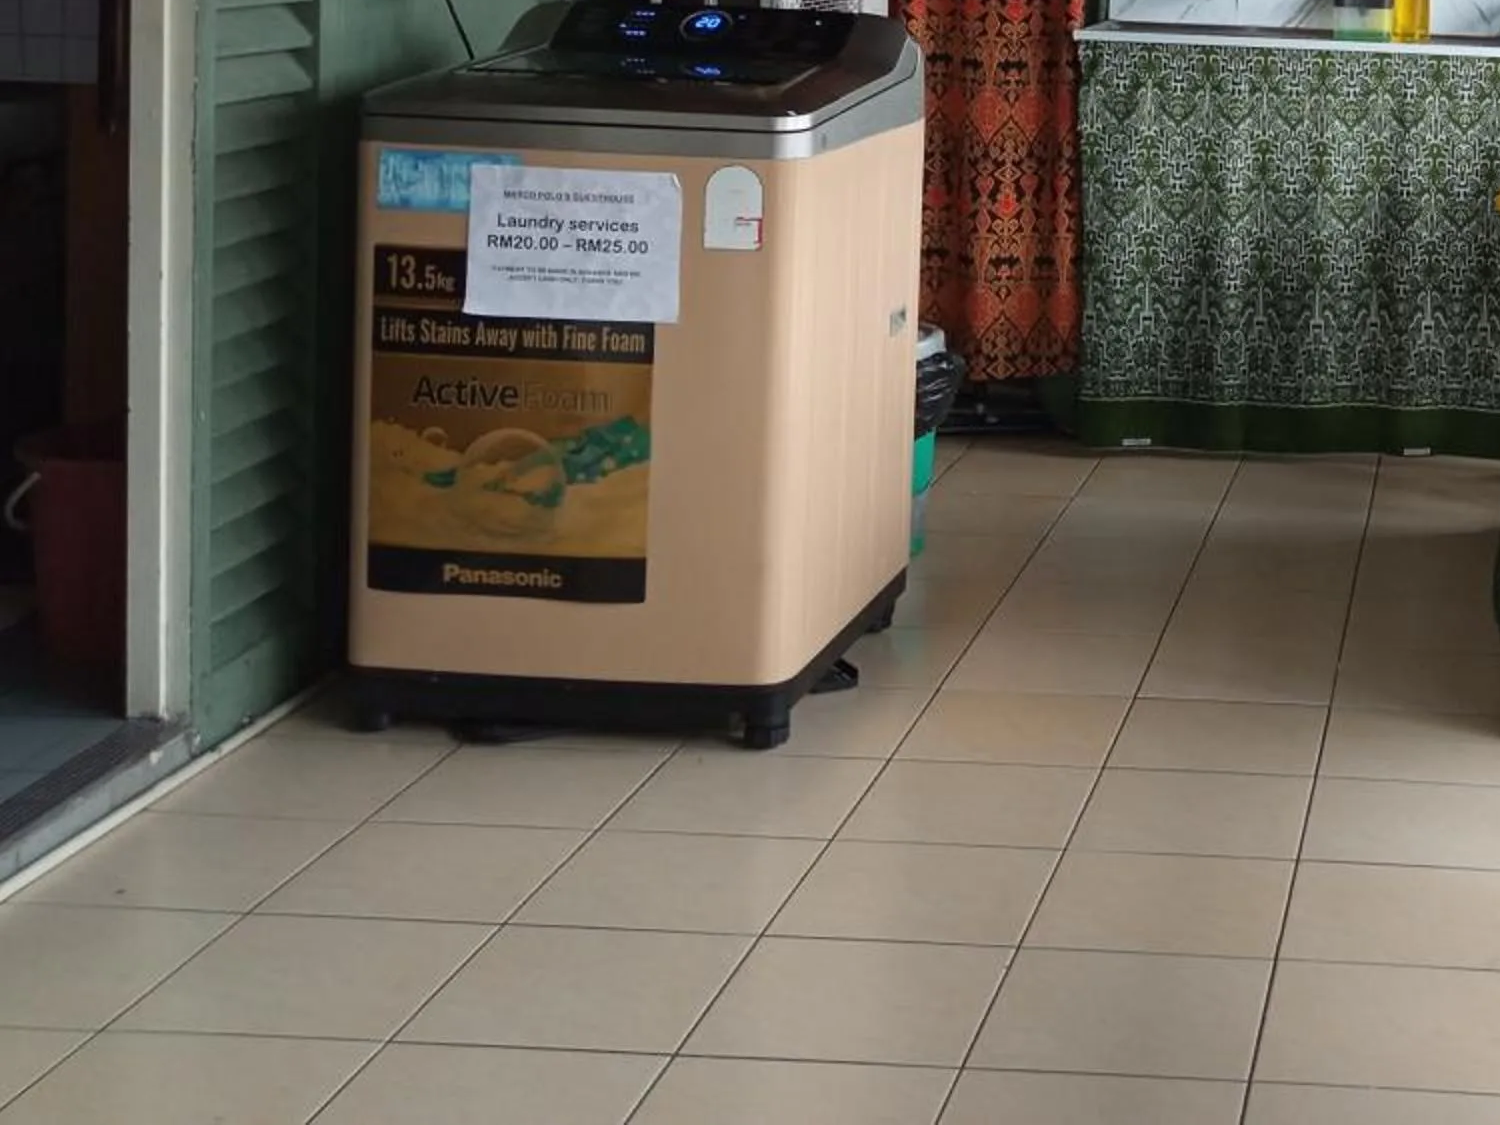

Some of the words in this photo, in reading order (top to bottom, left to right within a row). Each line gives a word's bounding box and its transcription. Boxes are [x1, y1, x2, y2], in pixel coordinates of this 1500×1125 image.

[695, 16, 721, 28] 20
[496, 213, 565, 234] Laundry
[568, 218, 640, 234] services
[487, 234, 559, 252] RM20.00
[575, 238, 649, 255] RM25.00
[386, 252, 456, 292] 13.5kg
[381, 316, 415, 343] Lifts
[420, 318, 471, 346] Stains
[474, 321, 518, 352] Away
[522, 324, 558, 350] with
[562, 323, 598, 352] Fine
[602, 326, 646, 354] Foam
[443, 563, 563, 588] Panasonic
